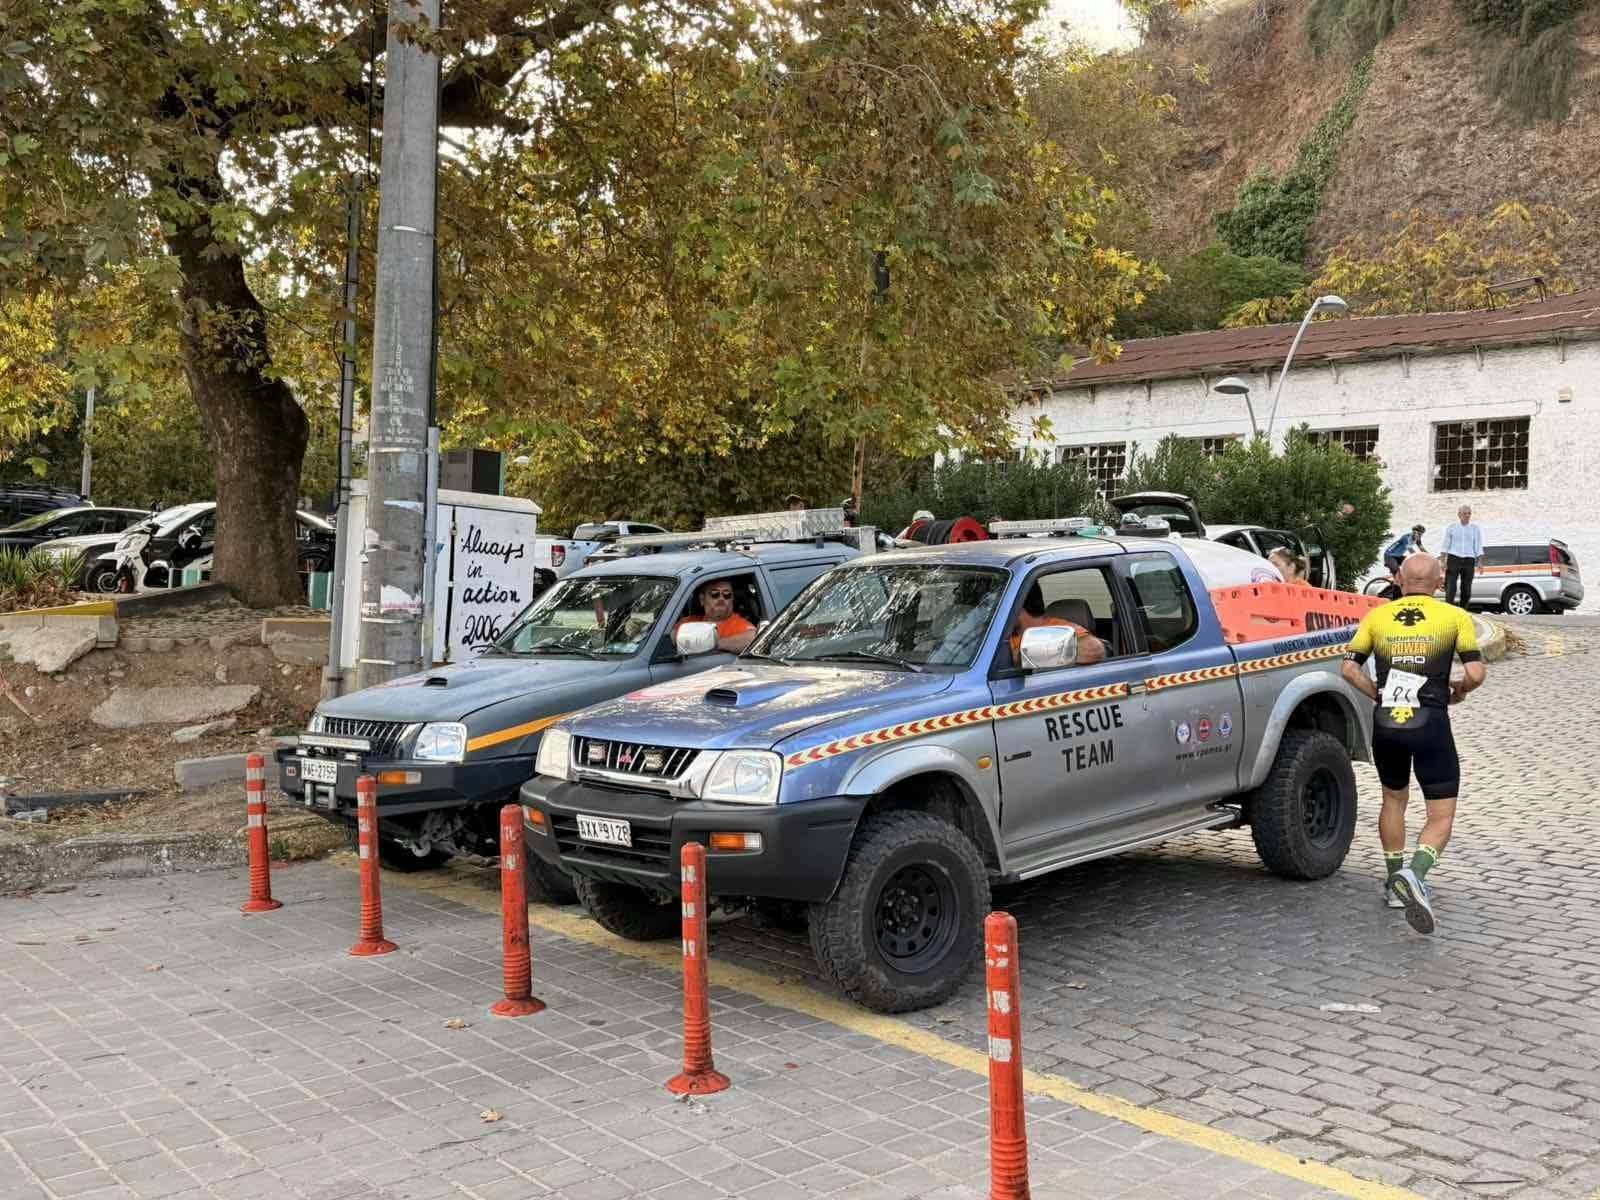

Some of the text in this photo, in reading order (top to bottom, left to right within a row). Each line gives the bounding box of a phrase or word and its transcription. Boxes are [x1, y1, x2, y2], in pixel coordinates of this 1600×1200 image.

[467, 560, 483, 578] in
[463, 581, 520, 604] action
[1391, 655, 1426, 665] PRO
[1045, 704, 1123, 742] RESCUE
[1062, 739, 1114, 773] TEAM
